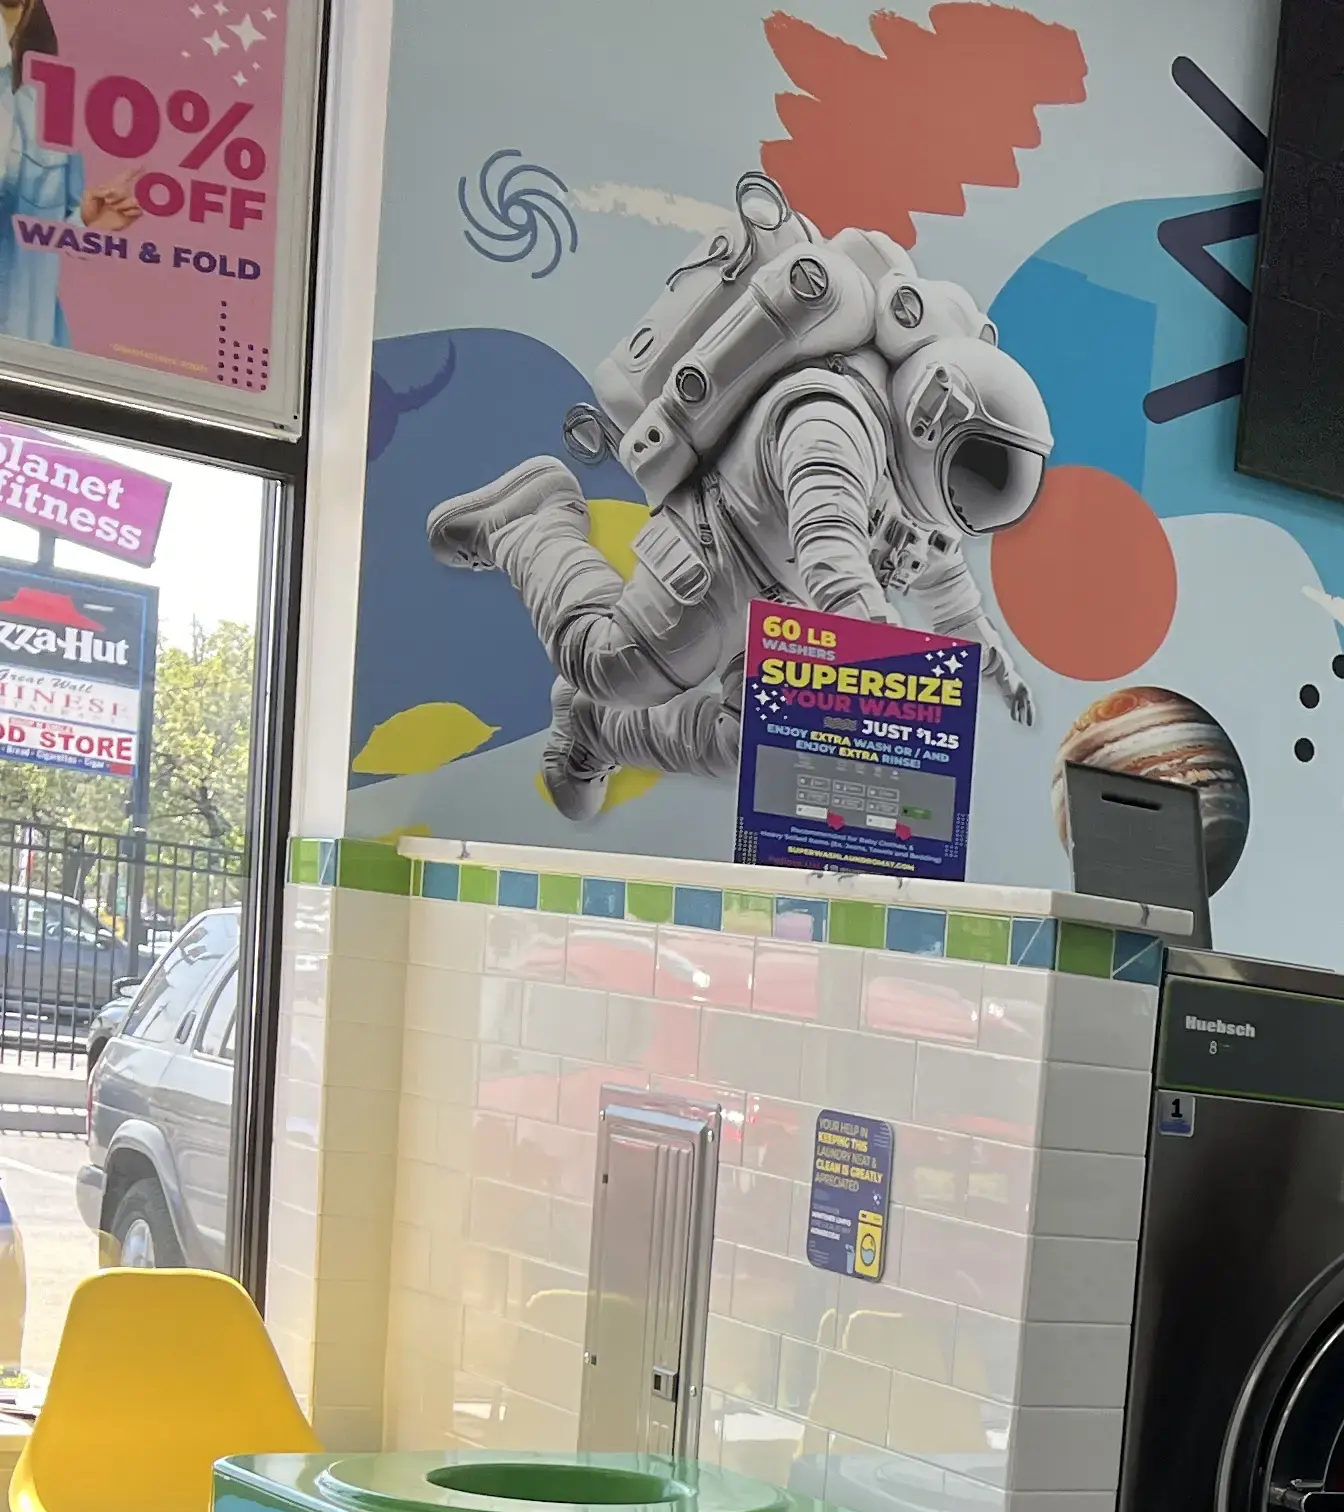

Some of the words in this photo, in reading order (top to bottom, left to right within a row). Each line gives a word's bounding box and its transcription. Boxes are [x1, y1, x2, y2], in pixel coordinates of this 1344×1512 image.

[30, 59, 266, 181] 10%
[134, 171, 267, 230] OFF
[17, 219, 128, 259] WASH
[138, 242, 162, 265] &
[172, 246, 262, 281] FOLD
[57, 626, 129, 665] Hut
[762, 615, 801, 641] 60
[807, 628, 837, 648] LB
[762, 637, 836, 661] WASHERS
[52, 677, 94, 694] Wall
[761, 658, 963, 707] SUPERSIZE
[782, 688, 851, 714] YOUR
[859, 698, 943, 724] WASH!
[40, 731, 133, 761] STORE
[767, 723, 809, 740] ENJOY
[810, 731, 851, 746] EXTRA
[853, 738, 893, 753] WASH
[894, 745, 912, 757] OR
[922, 750, 950, 763] AND
[796, 739, 836, 755] ENJOY
[838, 746, 879, 762] EXTRA
[862, 720, 912, 741] JUST
[916, 727, 960, 750] $1.25
[1185, 1015, 1256, 1038] Huebsch
[1171, 1098, 1183, 1119] 1
